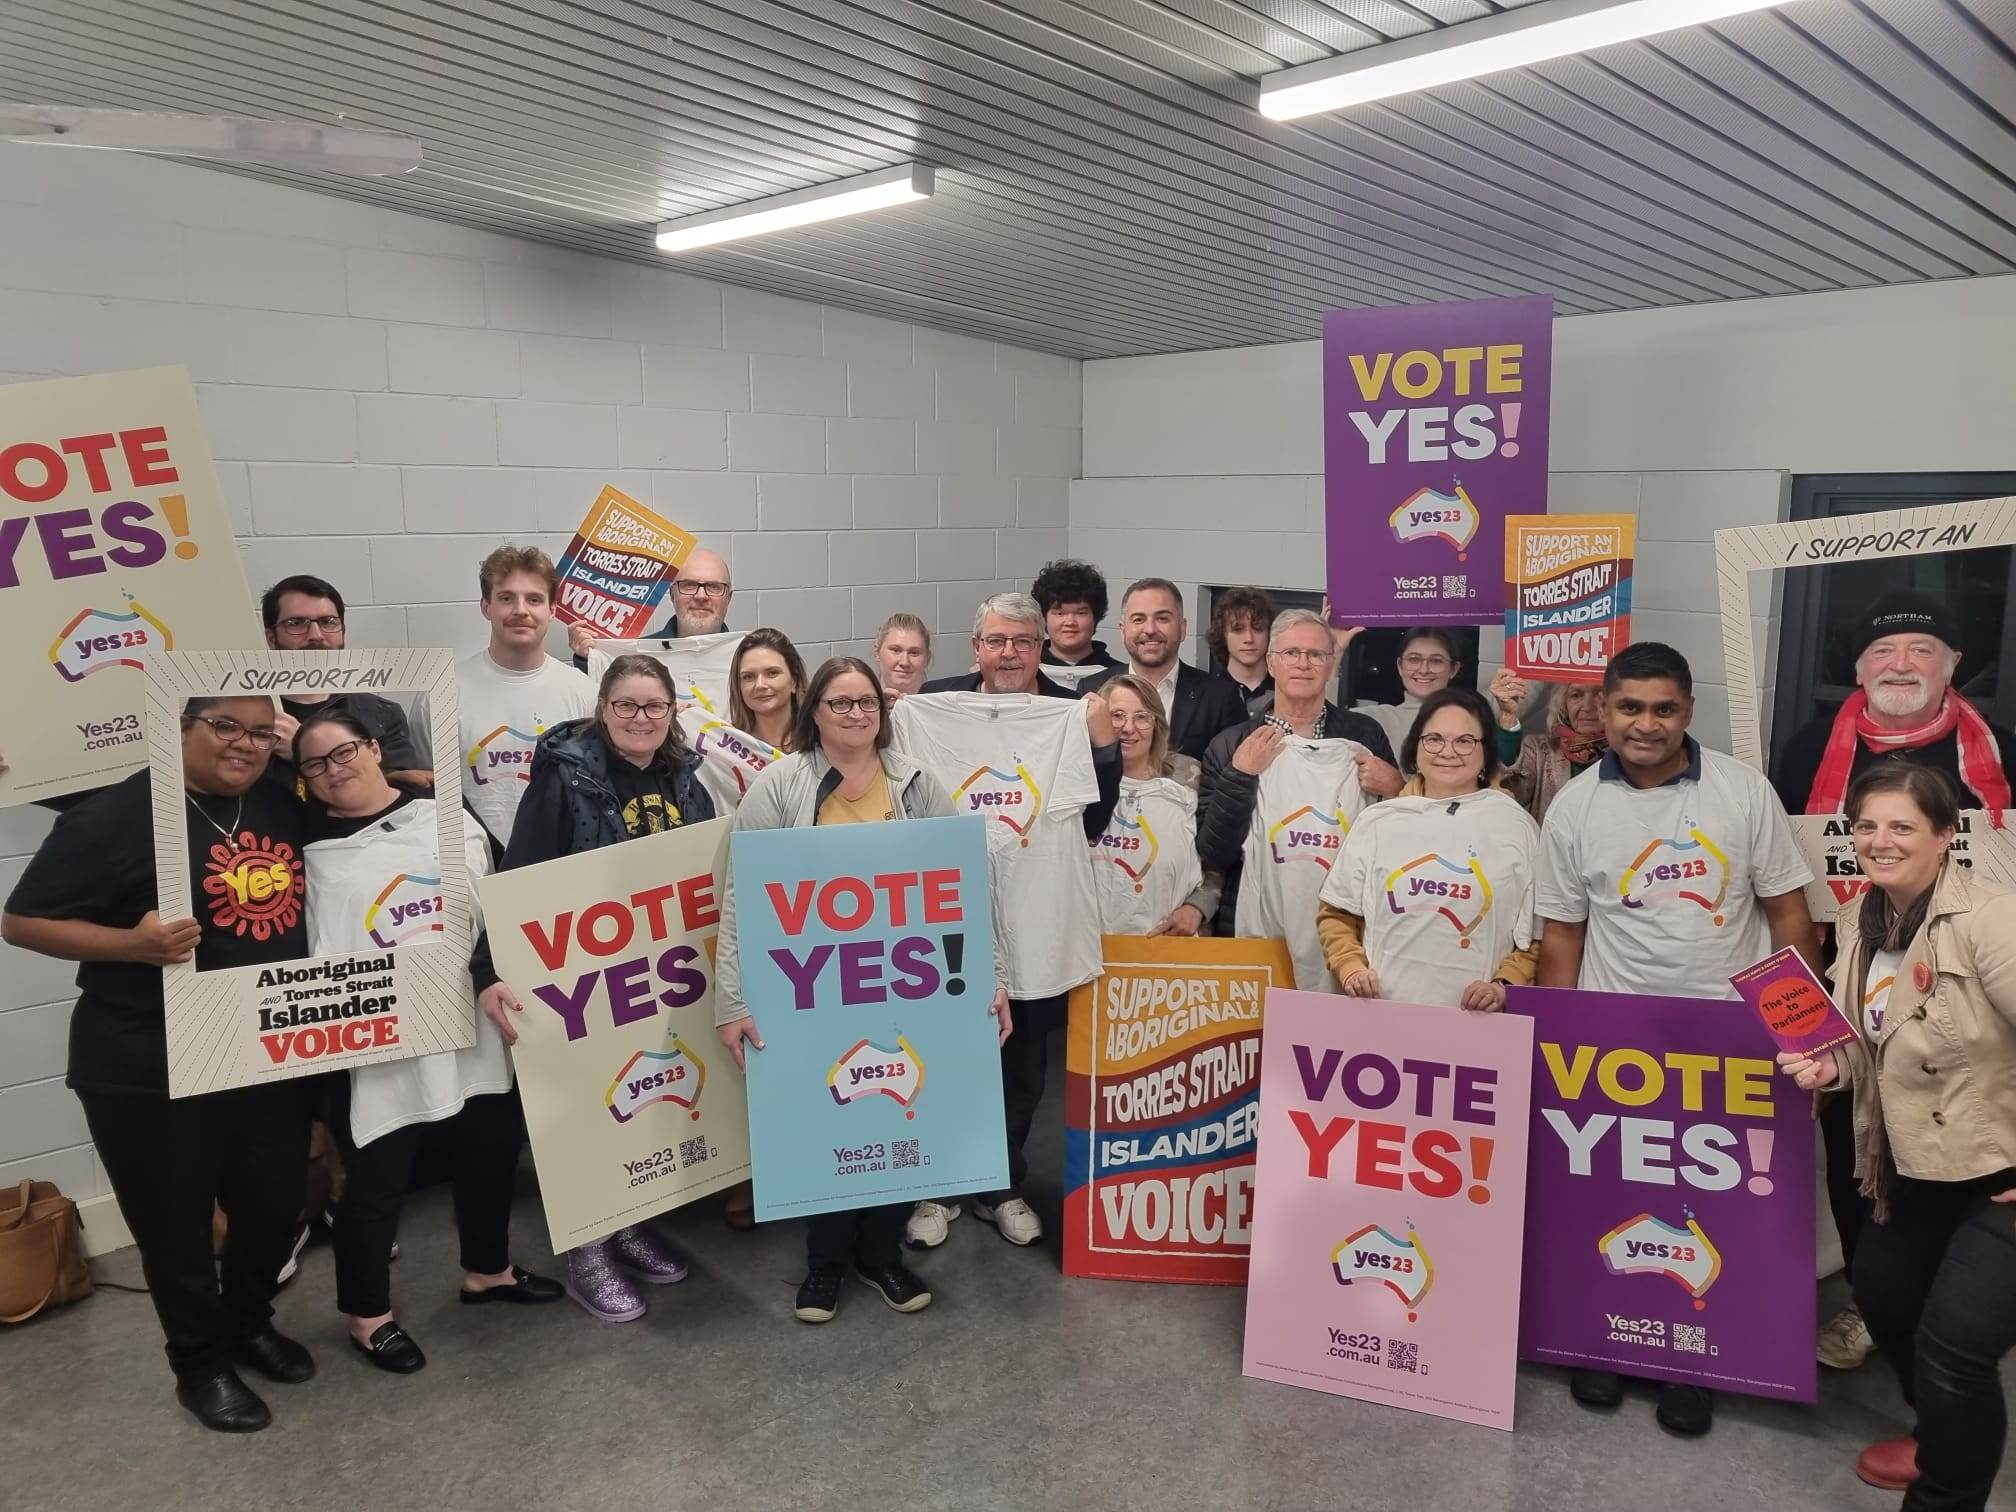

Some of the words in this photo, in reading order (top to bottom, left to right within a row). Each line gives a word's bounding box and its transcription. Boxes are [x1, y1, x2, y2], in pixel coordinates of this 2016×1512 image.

[1348, 344, 1523, 401] VOTE
[1348, 402, 1522, 464] YES!
[0, 426, 179, 502] OTE
[606, 509, 660, 543] SUPPORT
[659, 537, 675, 550] AN
[1409, 508, 1461, 527] yes23
[1526, 535, 1589, 557] SUPPORT
[1595, 535, 1612, 545] AN
[1786, 543, 1798, 562] I
[1805, 527, 1936, 560] SUPPORT
[1933, 522, 1978, 545] AN
[583, 547, 628, 573] TORRES
[624, 556, 662, 578] STRAIT
[571, 567, 650, 600] ISLANDER
[1393, 576, 1437, 590] Yes23
[1393, 588, 1437, 599] .com.au
[1524, 576, 1570, 607] TORRES
[1570, 564, 1612, 599] STRAIT
[561, 582, 636, 636] VOICE
[1523, 595, 1611, 628] ISLANDER
[75, 630, 148, 660] yes23
[1523, 627, 1609, 666] VOICE
[220, 672, 232, 691] I
[239, 668, 359, 690] SUPPORT
[356, 667, 392, 688] AN
[77, 715, 139, 738] Yes23
[84, 731, 144, 751] .com.au
[487, 750, 533, 767] yes2
[717, 732, 768, 772] yes23
[969, 791, 1023, 811] yes23
[1288, 831, 1340, 849] yes23
[219, 863, 291, 904] Yes
[1409, 876, 1471, 900] yes23
[1644, 860, 1708, 888] yes23
[389, 896, 442, 926] yes2
[764, 868, 963, 936] VOTE
[519, 872, 720, 971] VOTE
[256, 953, 395, 988] Aboriginal
[768, 933, 966, 1011] YES!
[260, 995, 281, 1006] AND
[283, 985, 341, 1003] Torres
[346, 976, 393, 993] Strait
[1106, 976, 1219, 1021] SUPPORT
[1228, 980, 1259, 1002] AN
[1762, 999, 1783, 1011] The
[1781, 985, 1810, 1001] Voice
[1786, 1002, 1799, 1011] to
[258, 995, 397, 1031] Islander
[1771, 1000, 1827, 1031] Parliament
[260, 1015, 400, 1064] VOICE
[627, 1065, 686, 1099] yes23
[850, 1062, 906, 1085] yes23
[1103, 1060, 1187, 1123] TORRES
[1188, 1038, 1259, 1108] STRAIT
[1292, 1044, 1498, 1126] VOTE
[1540, 1041, 1775, 1117] VOTE
[1101, 1101, 1259, 1168] ISLANDER
[623, 1147, 674, 1176] Yes23
[833, 1142, 885, 1164] Yes23
[1287, 1109, 1495, 1205] YES!
[1541, 1108, 1775, 1196] YES!
[627, 1162, 677, 1189] .com.au
[834, 1159, 886, 1177] .com.au
[1100, 1166, 1254, 1245] VOICE
[1354, 1249, 1413, 1274] yes23
[1625, 1239, 1696, 1263] yes23
[1327, 1327, 1381, 1352] Yes23
[1605, 1314, 1665, 1335] Yes23
[1606, 1330, 1665, 1349] .com.au
[1326, 1346, 1380, 1366] .com.au
